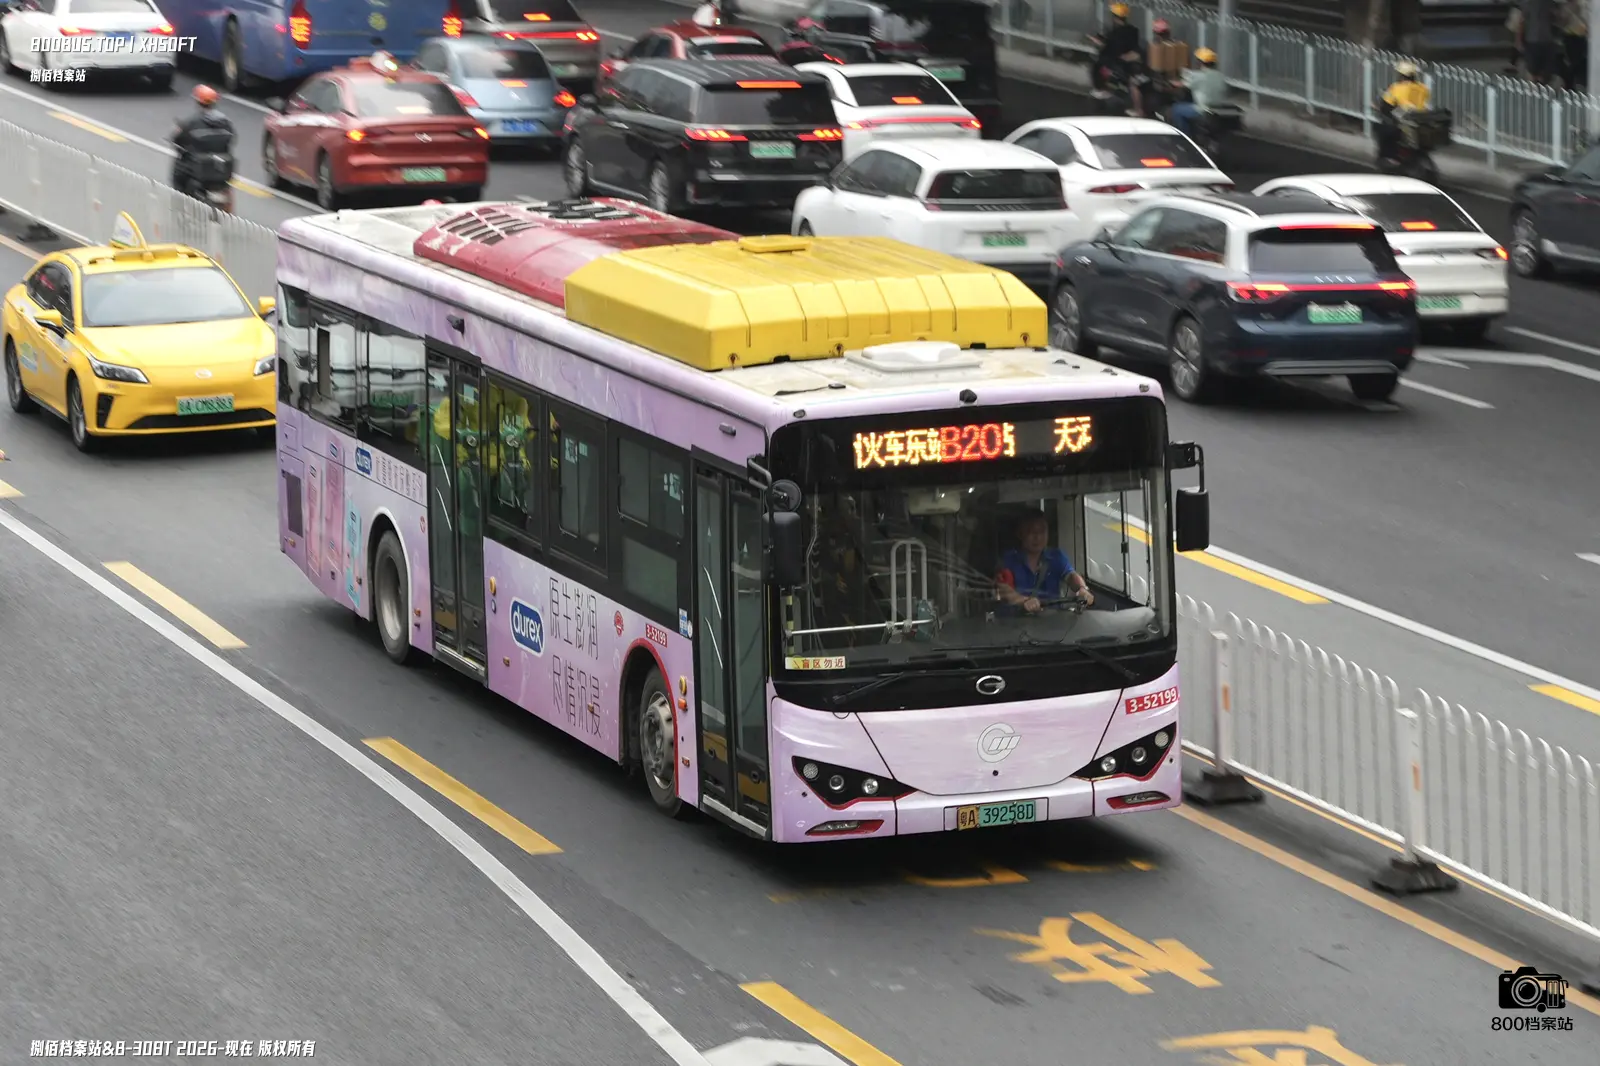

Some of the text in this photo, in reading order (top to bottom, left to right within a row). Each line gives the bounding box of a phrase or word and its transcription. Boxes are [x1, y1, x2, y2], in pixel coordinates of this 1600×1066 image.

[512, 604, 542, 650] durex
[647, 624, 667, 646] 3-52199
[1129, 687, 1177, 713] 3-52199
